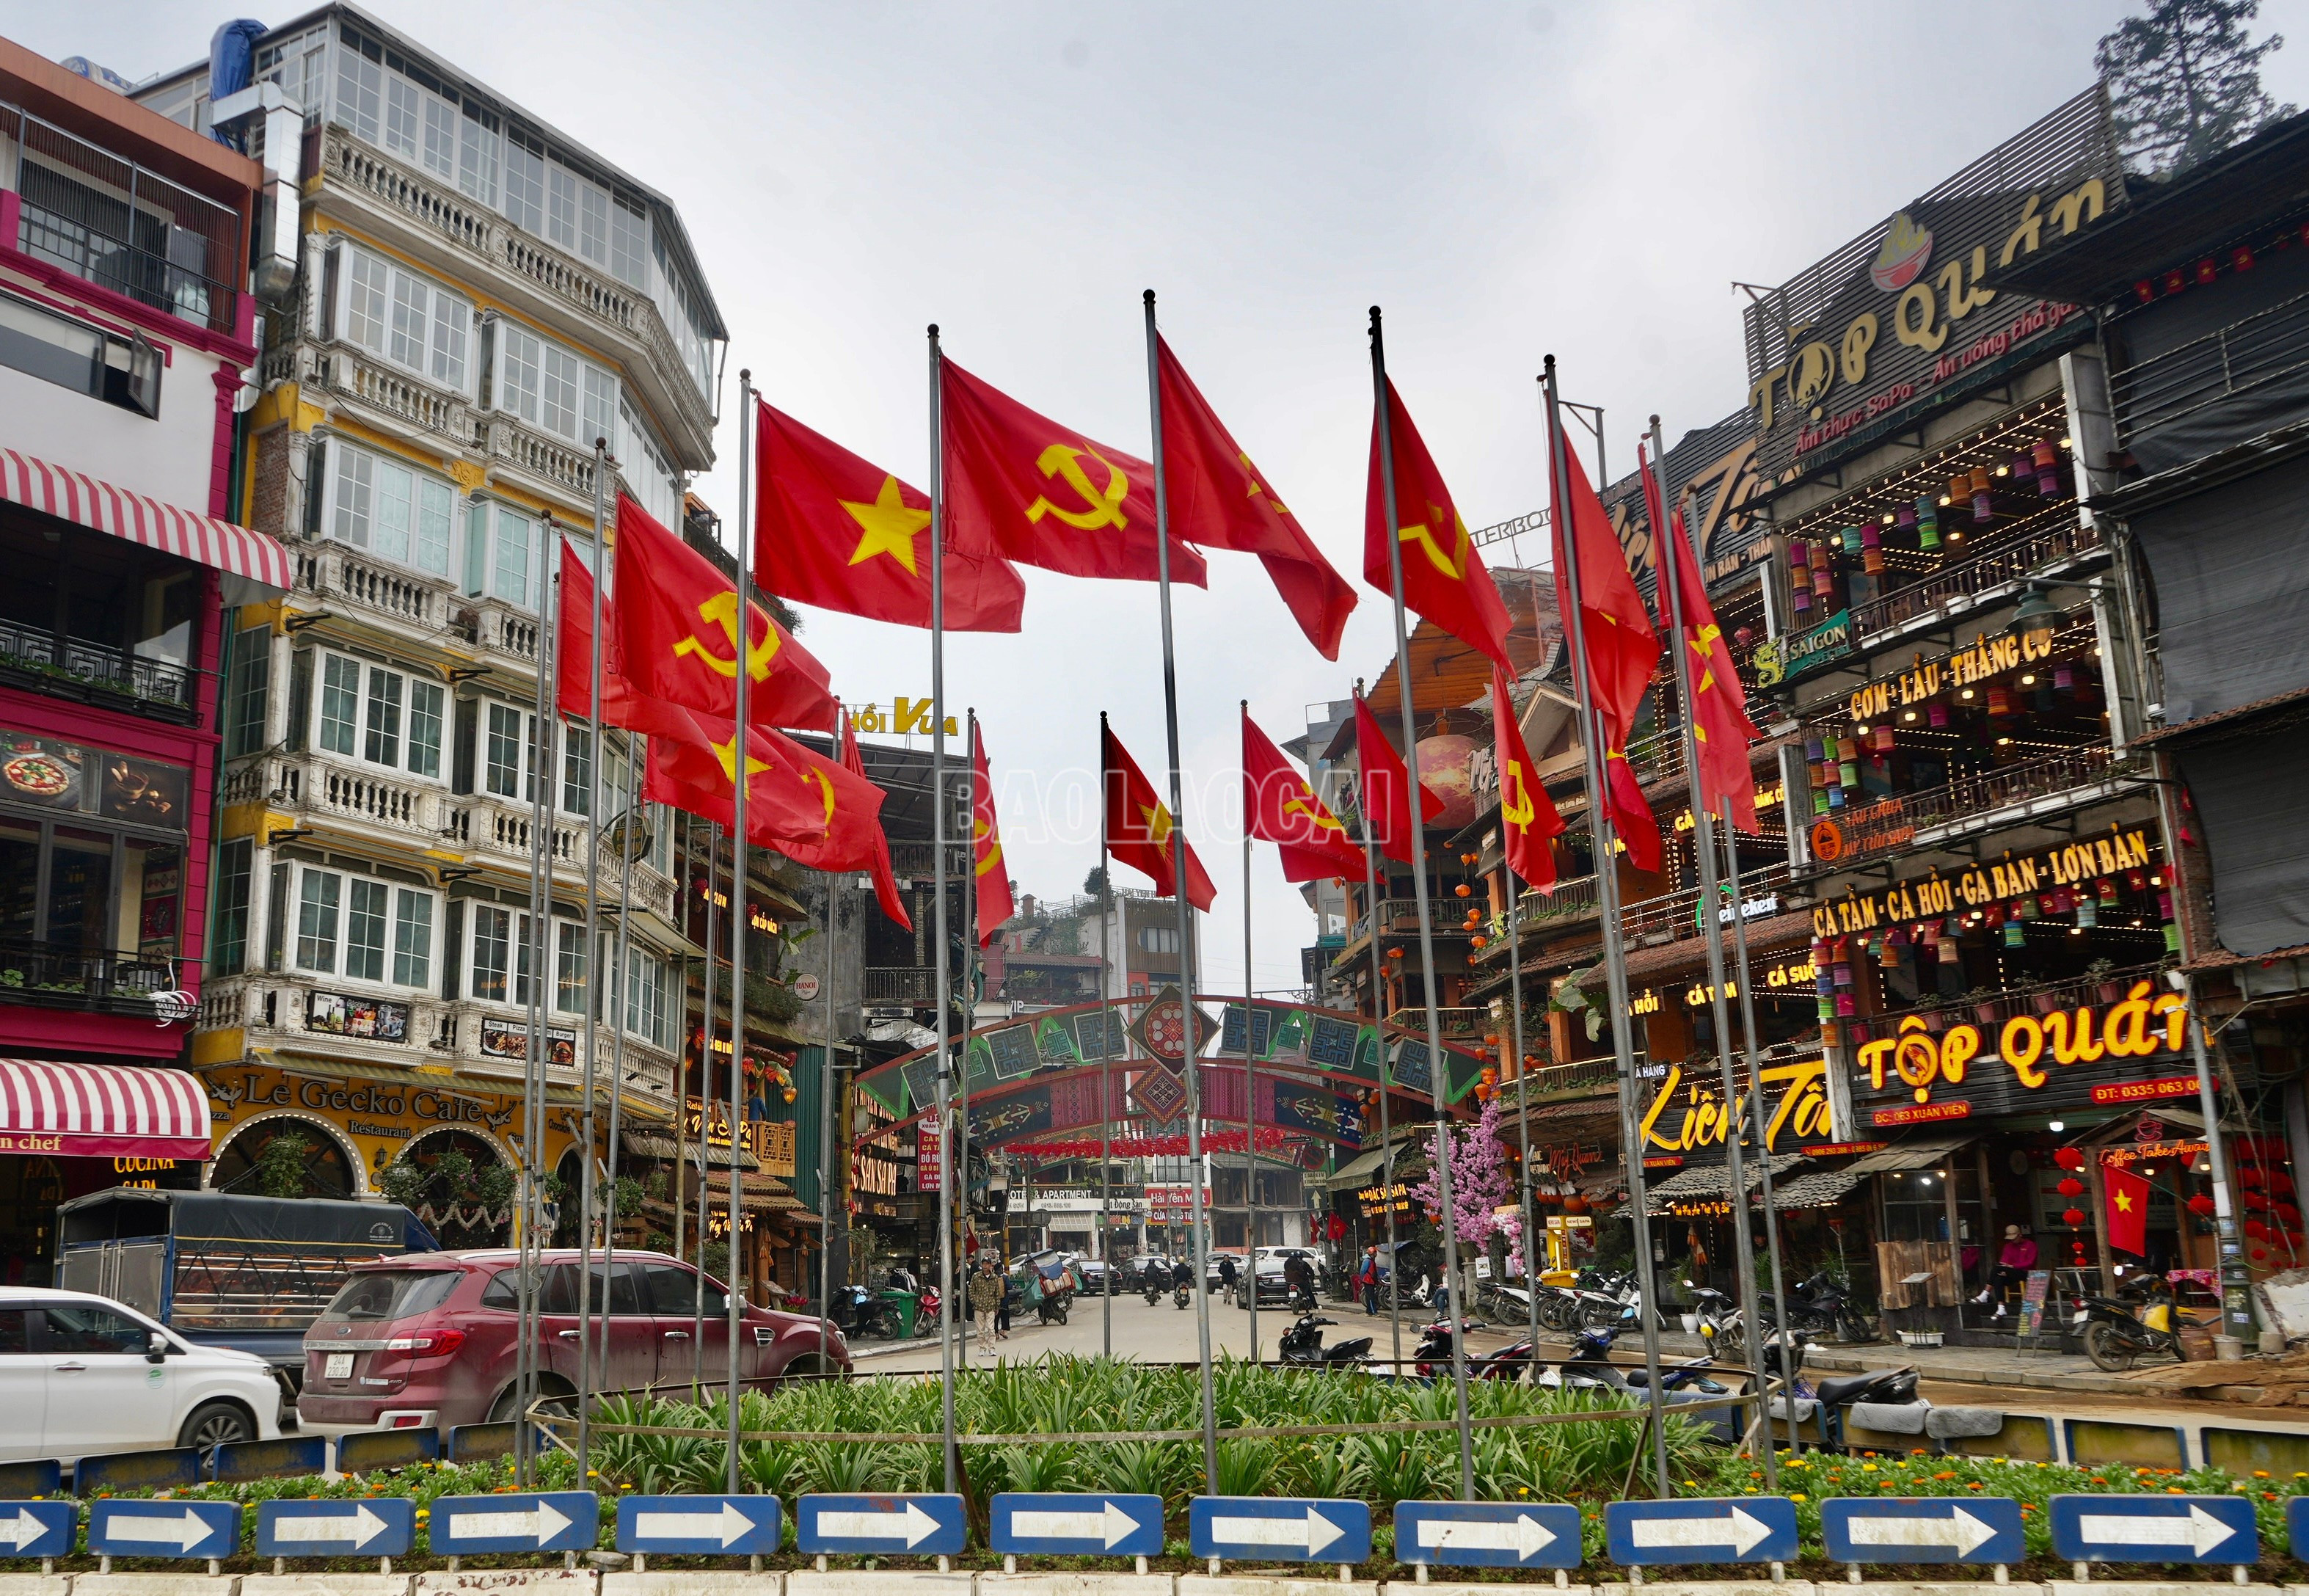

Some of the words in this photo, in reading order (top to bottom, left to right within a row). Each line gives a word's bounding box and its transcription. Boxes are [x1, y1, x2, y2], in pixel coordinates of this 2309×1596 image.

[1790, 624, 1847, 660] SAIGON
[796, 982, 817, 990] HANOI
[316, 994, 332, 1003] Wine
[488, 1021, 503, 1029] Steak
[1643, 1064, 1666, 1079] HÀNG
[2121, 1083, 2156, 1098] 0335
[2158, 1081, 2184, 1095] 063
[2188, 1079, 2202, 1093] 06
[244, 1074, 292, 1105] Le
[300, 1080, 406, 1117] Gecko
[210, 1109, 231, 1121] zza
[1894, 1109, 1910, 1122] 063
[349, 1120, 412, 1139] Restaurant
[18, 1134, 63, 1151] chef
[2100, 1148, 2137, 1167] Coffee
[1043, 1189, 1092, 1200] APARTMENT
[1150, 1192, 1165, 1203] Hải
[1185, 1192, 1206, 1203] Mt
[1114, 1198, 1131, 1209] Động
[1153, 1209, 1166, 1220] CỬA
[334, 1355, 346, 1365] 24A
[327, 1366, 349, 1377] 230.20
